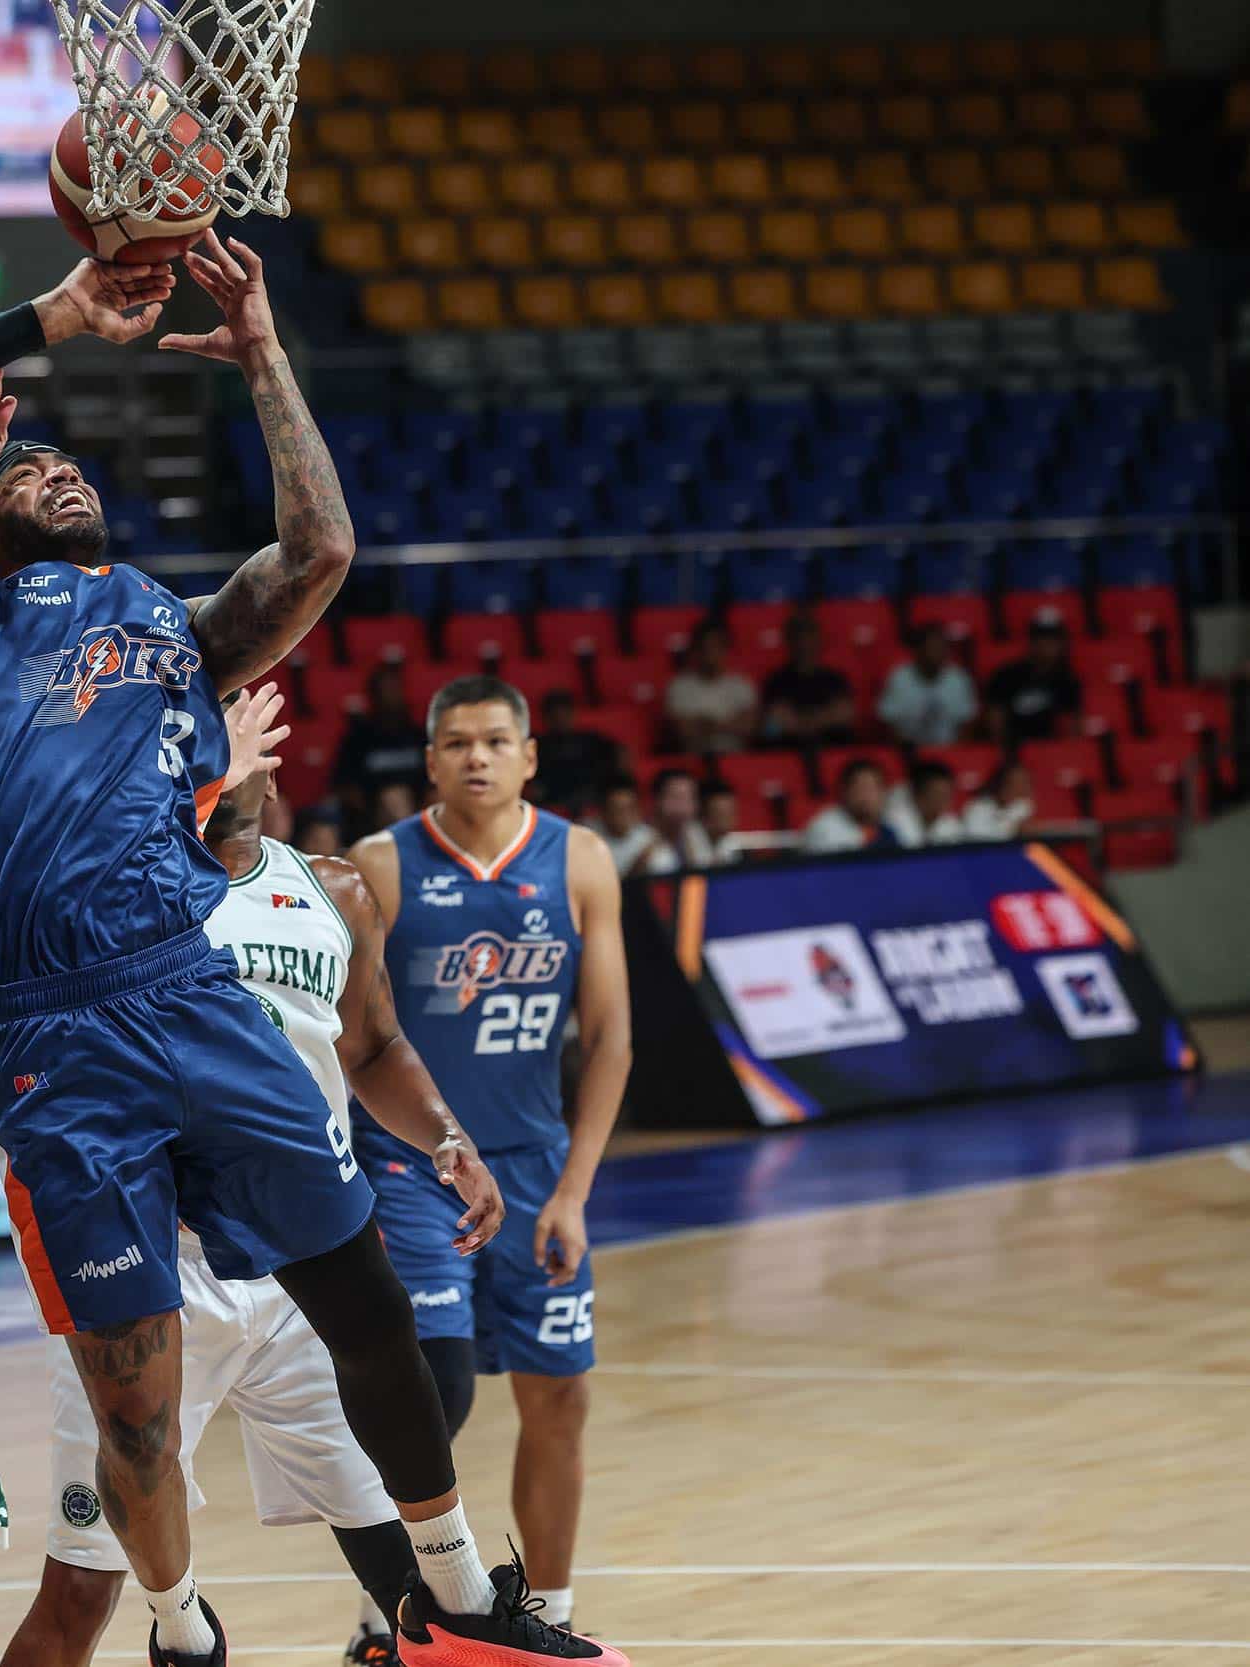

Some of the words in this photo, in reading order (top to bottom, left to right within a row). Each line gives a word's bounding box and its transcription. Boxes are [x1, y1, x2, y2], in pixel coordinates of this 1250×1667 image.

[47, 624, 203, 691] BOLTS
[145, 625, 188, 644] MERALCO
[434, 930, 568, 990] BOLTS
[474, 993, 561, 1055] 29
[536, 1290, 595, 1345] 29
[415, 1536, 466, 1556] adidas
